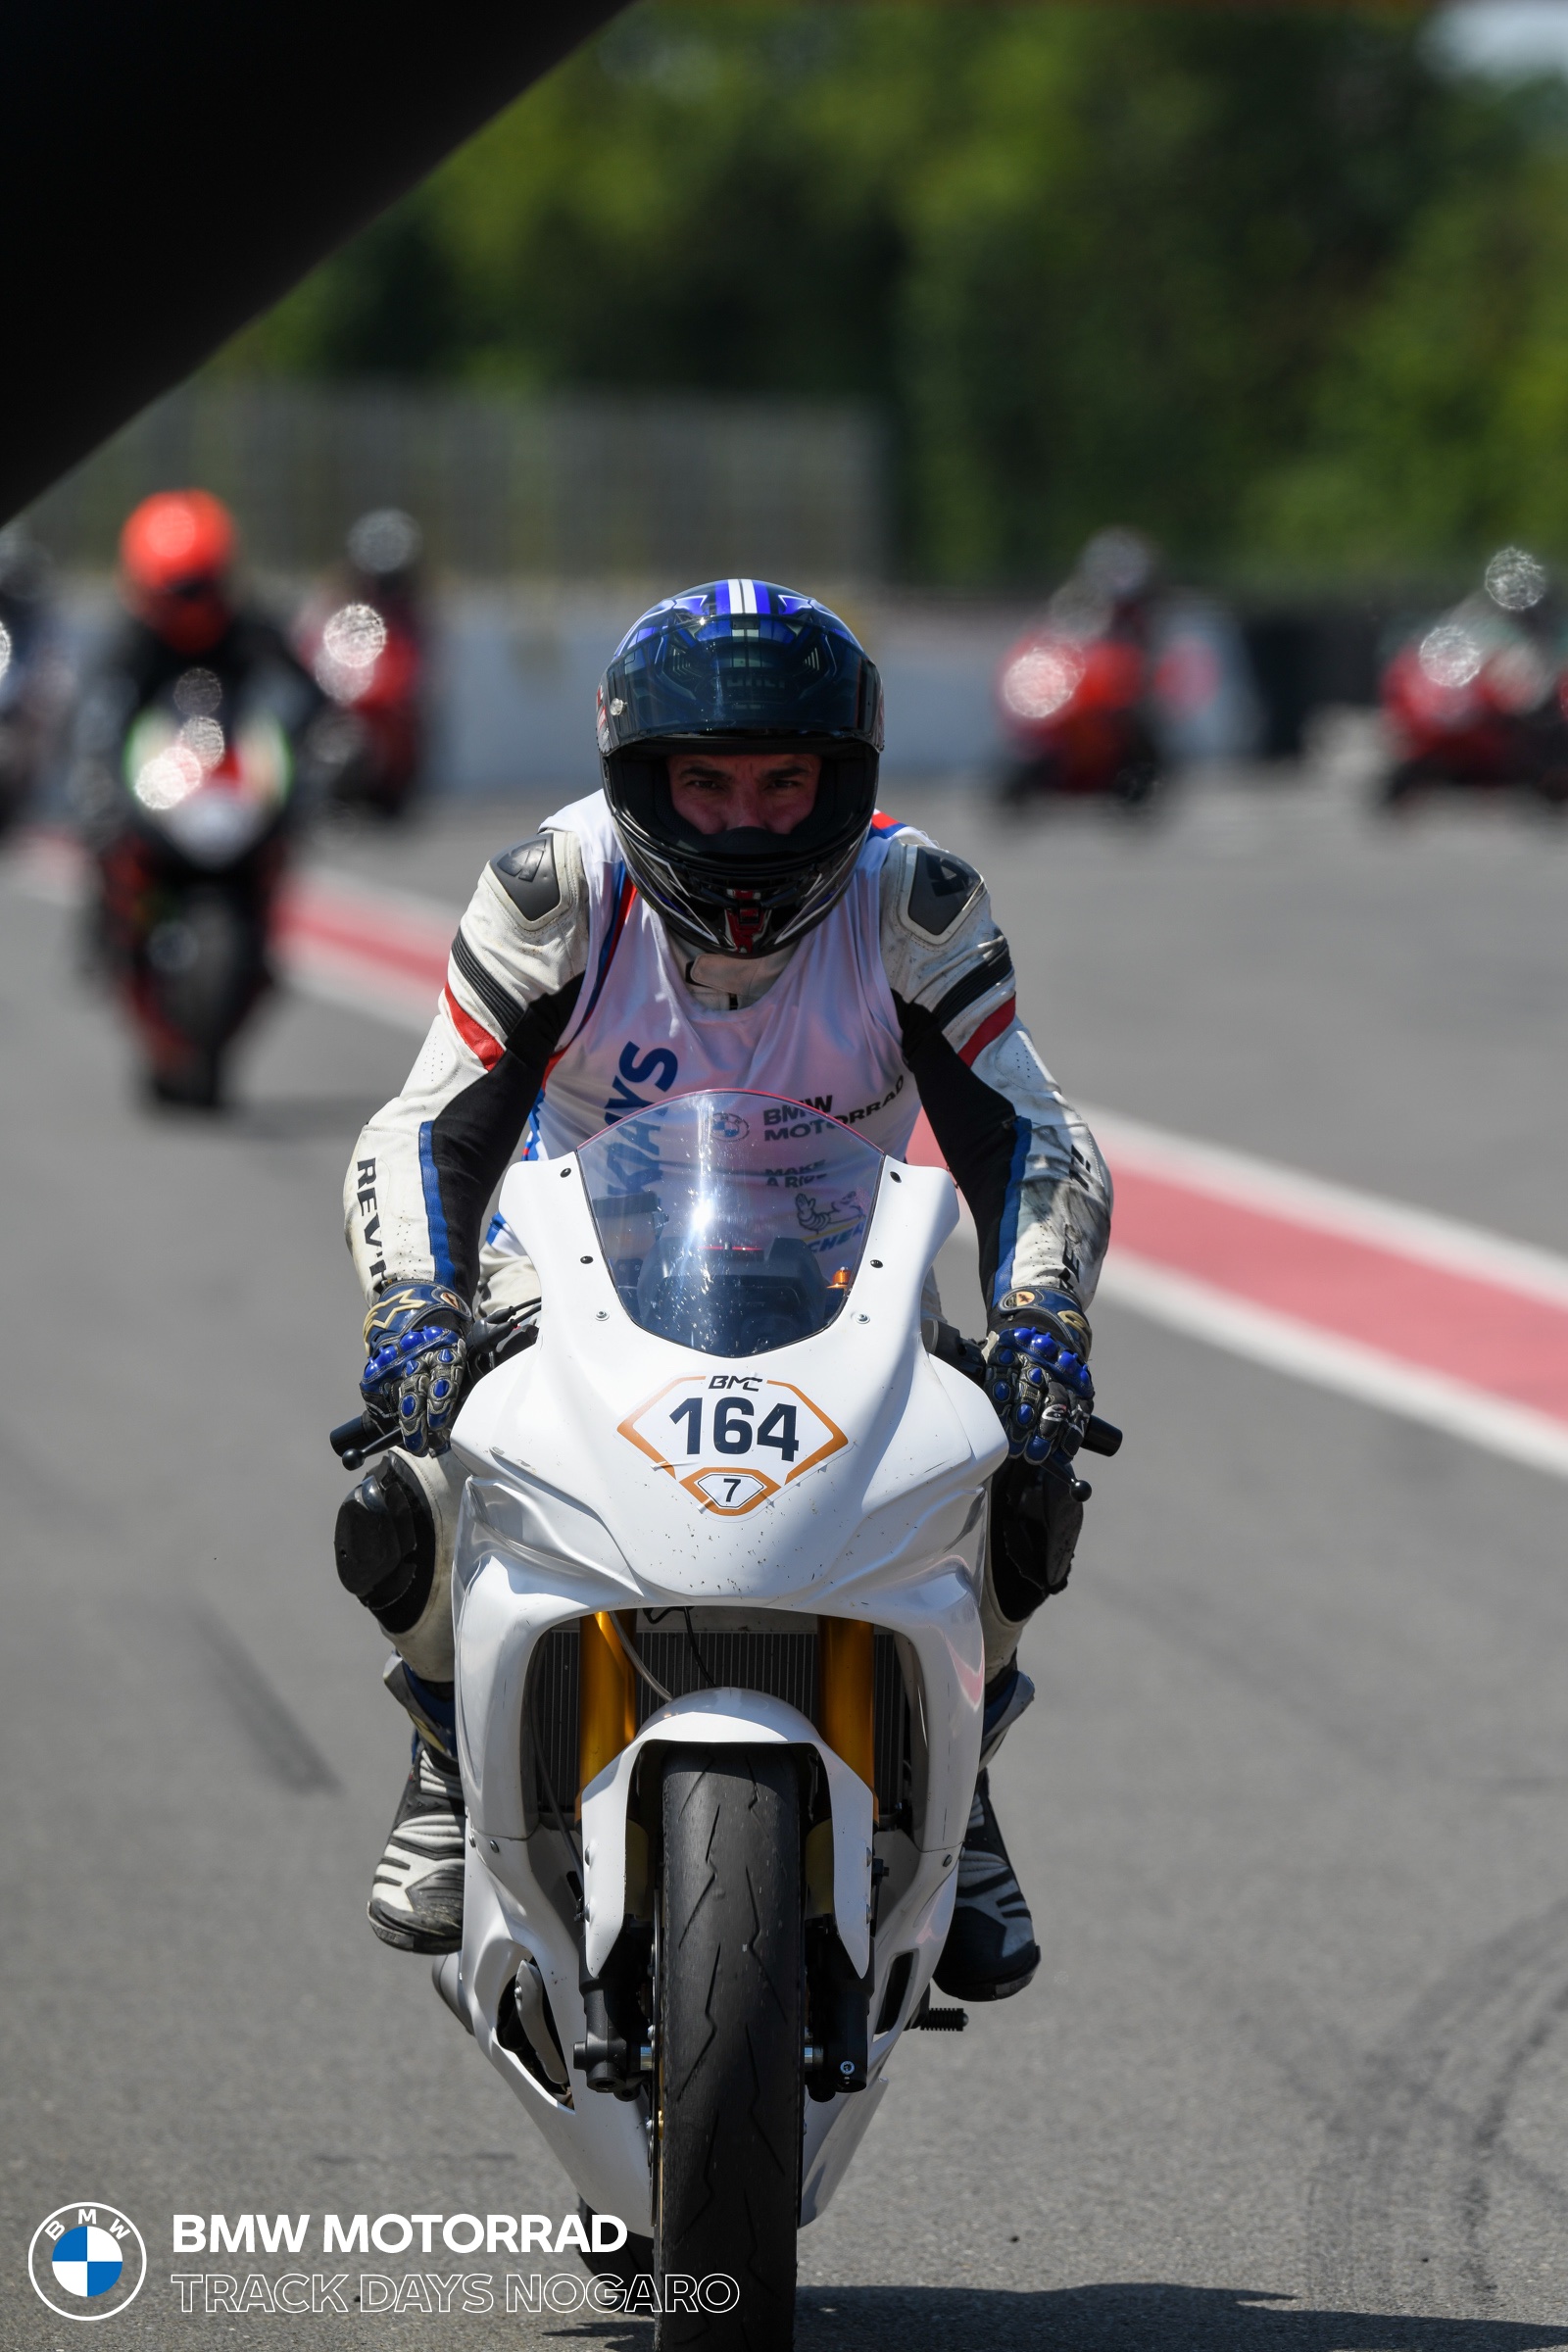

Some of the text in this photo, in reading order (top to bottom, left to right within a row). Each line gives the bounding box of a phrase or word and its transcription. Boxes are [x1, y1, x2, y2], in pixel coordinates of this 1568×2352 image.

[763, 1095, 834, 1126] BMW
[764, 1075, 904, 1142] MOTORRAD
[357, 1157, 386, 1280] REV'I
[709, 1375, 763, 1392] BMC
[669, 1396, 800, 1462] 164
[723, 1478, 741, 1502] 7
